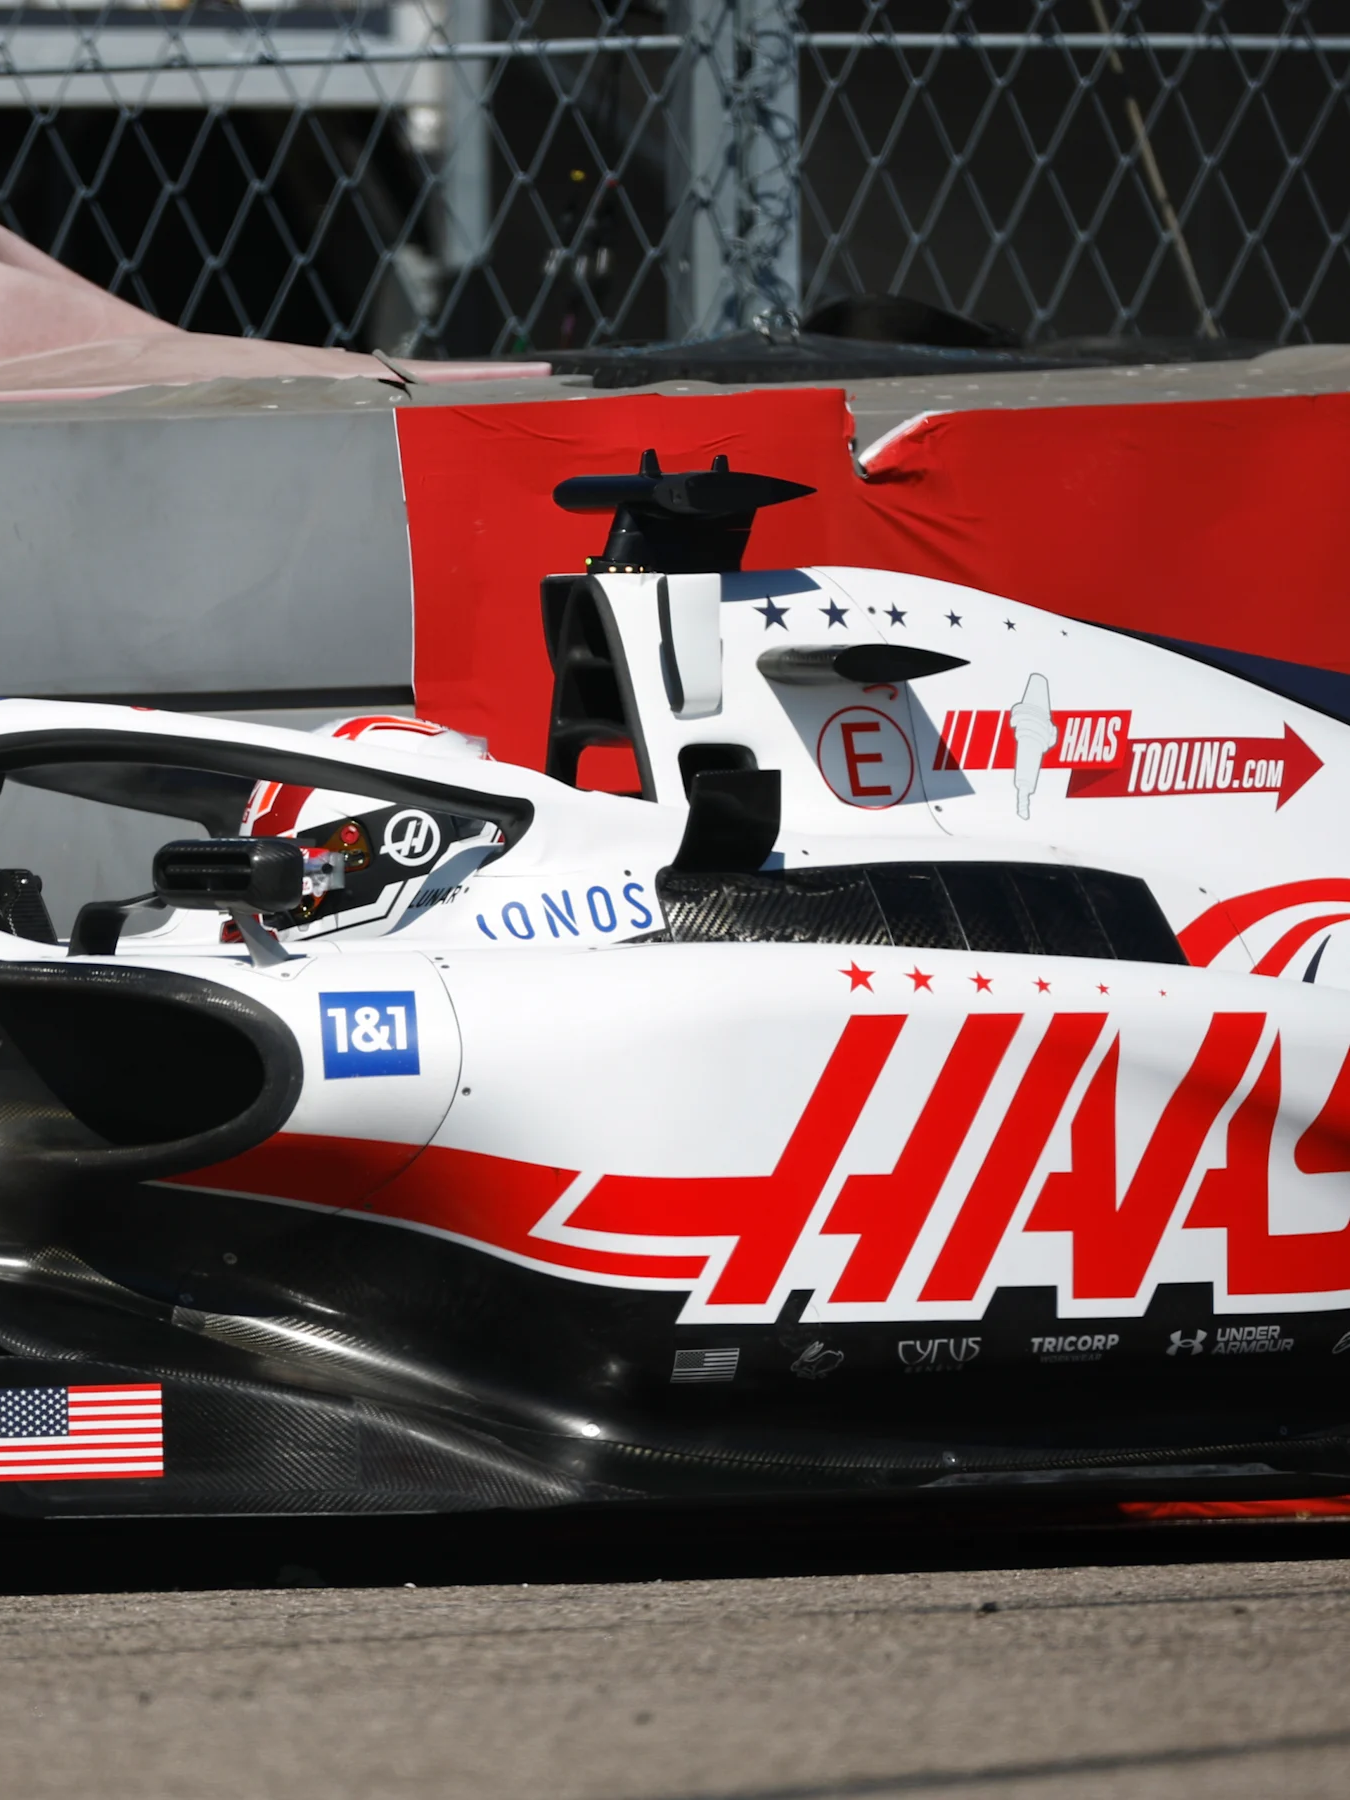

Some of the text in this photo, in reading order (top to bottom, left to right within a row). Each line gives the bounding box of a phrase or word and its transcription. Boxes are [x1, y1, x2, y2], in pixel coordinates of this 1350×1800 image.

[841, 721, 893, 797] E
[1059, 716, 1122, 763] HAAS
[476, 882, 653, 940] IONOS
[327, 1006, 407, 1053] 1&1
[1031, 1334, 1120, 1353] TRICORP
[1210, 1338, 1295, 1356] ARMOUR
[1216, 1325, 1281, 1342] UNDER
